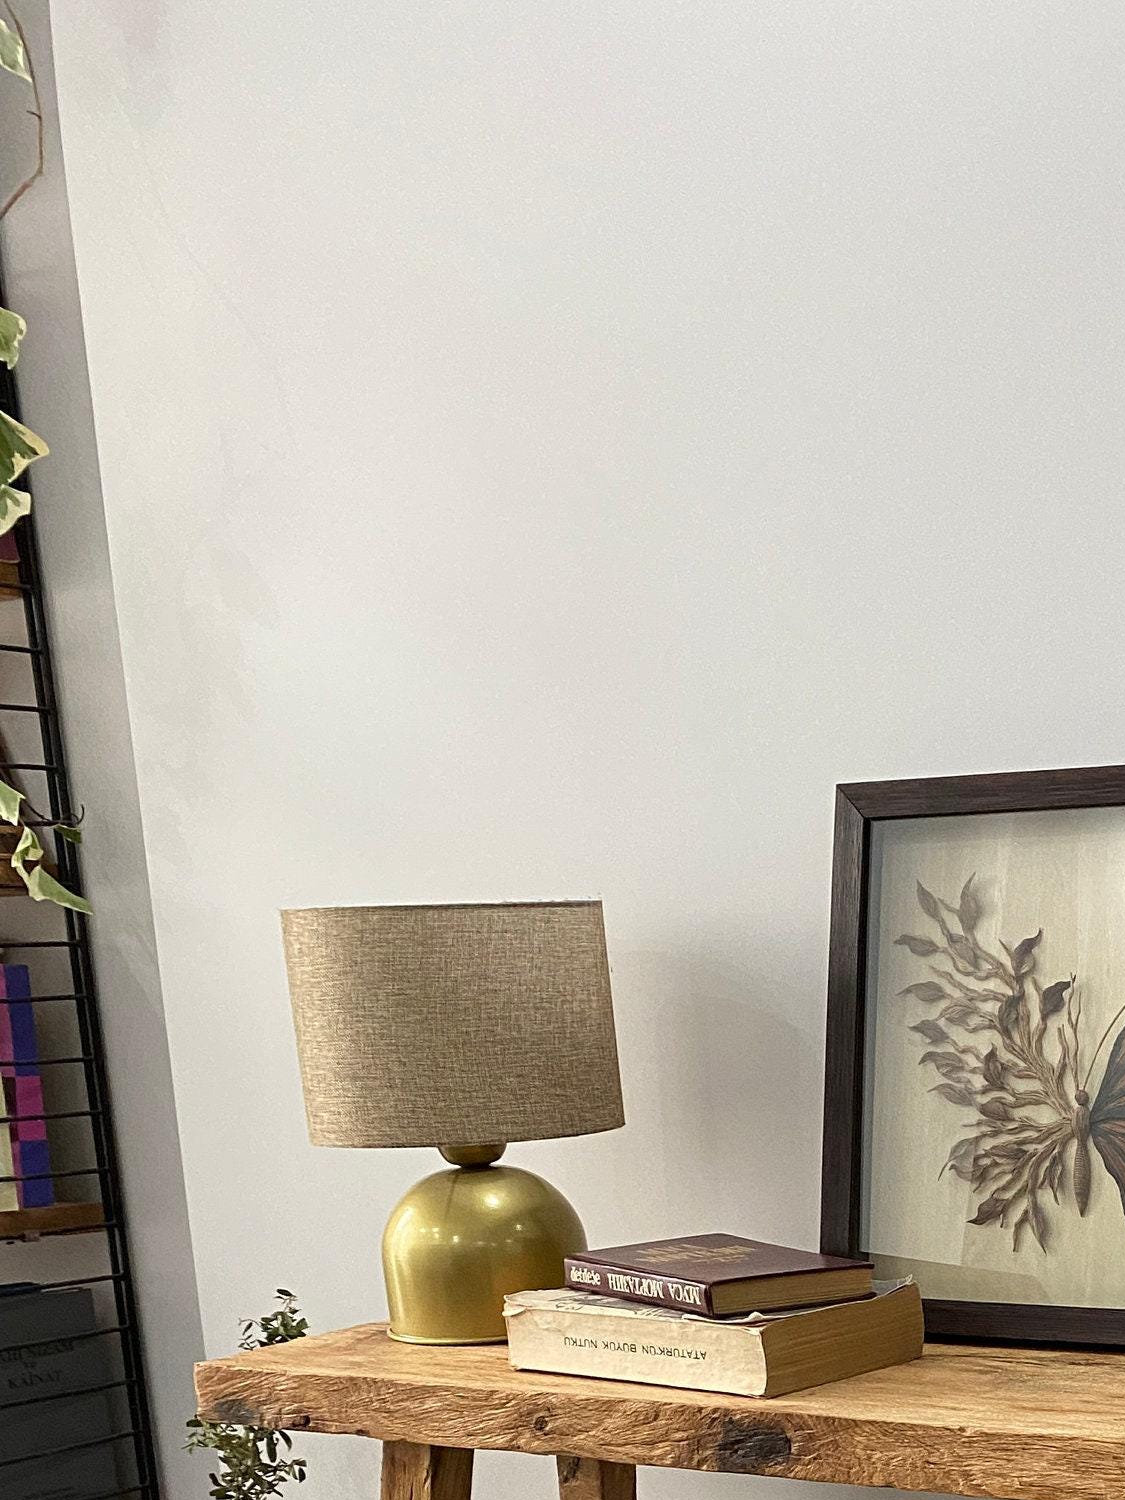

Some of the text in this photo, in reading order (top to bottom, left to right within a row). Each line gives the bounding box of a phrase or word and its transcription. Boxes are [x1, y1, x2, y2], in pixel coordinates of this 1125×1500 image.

[607, 1272, 665, 1299] МОРТАЗИН
[667, 1282, 702, 1305] МУСА
[563, 1336, 598, 1349] NUTKU
[601, 1340, 637, 1353] BÜYÜK
